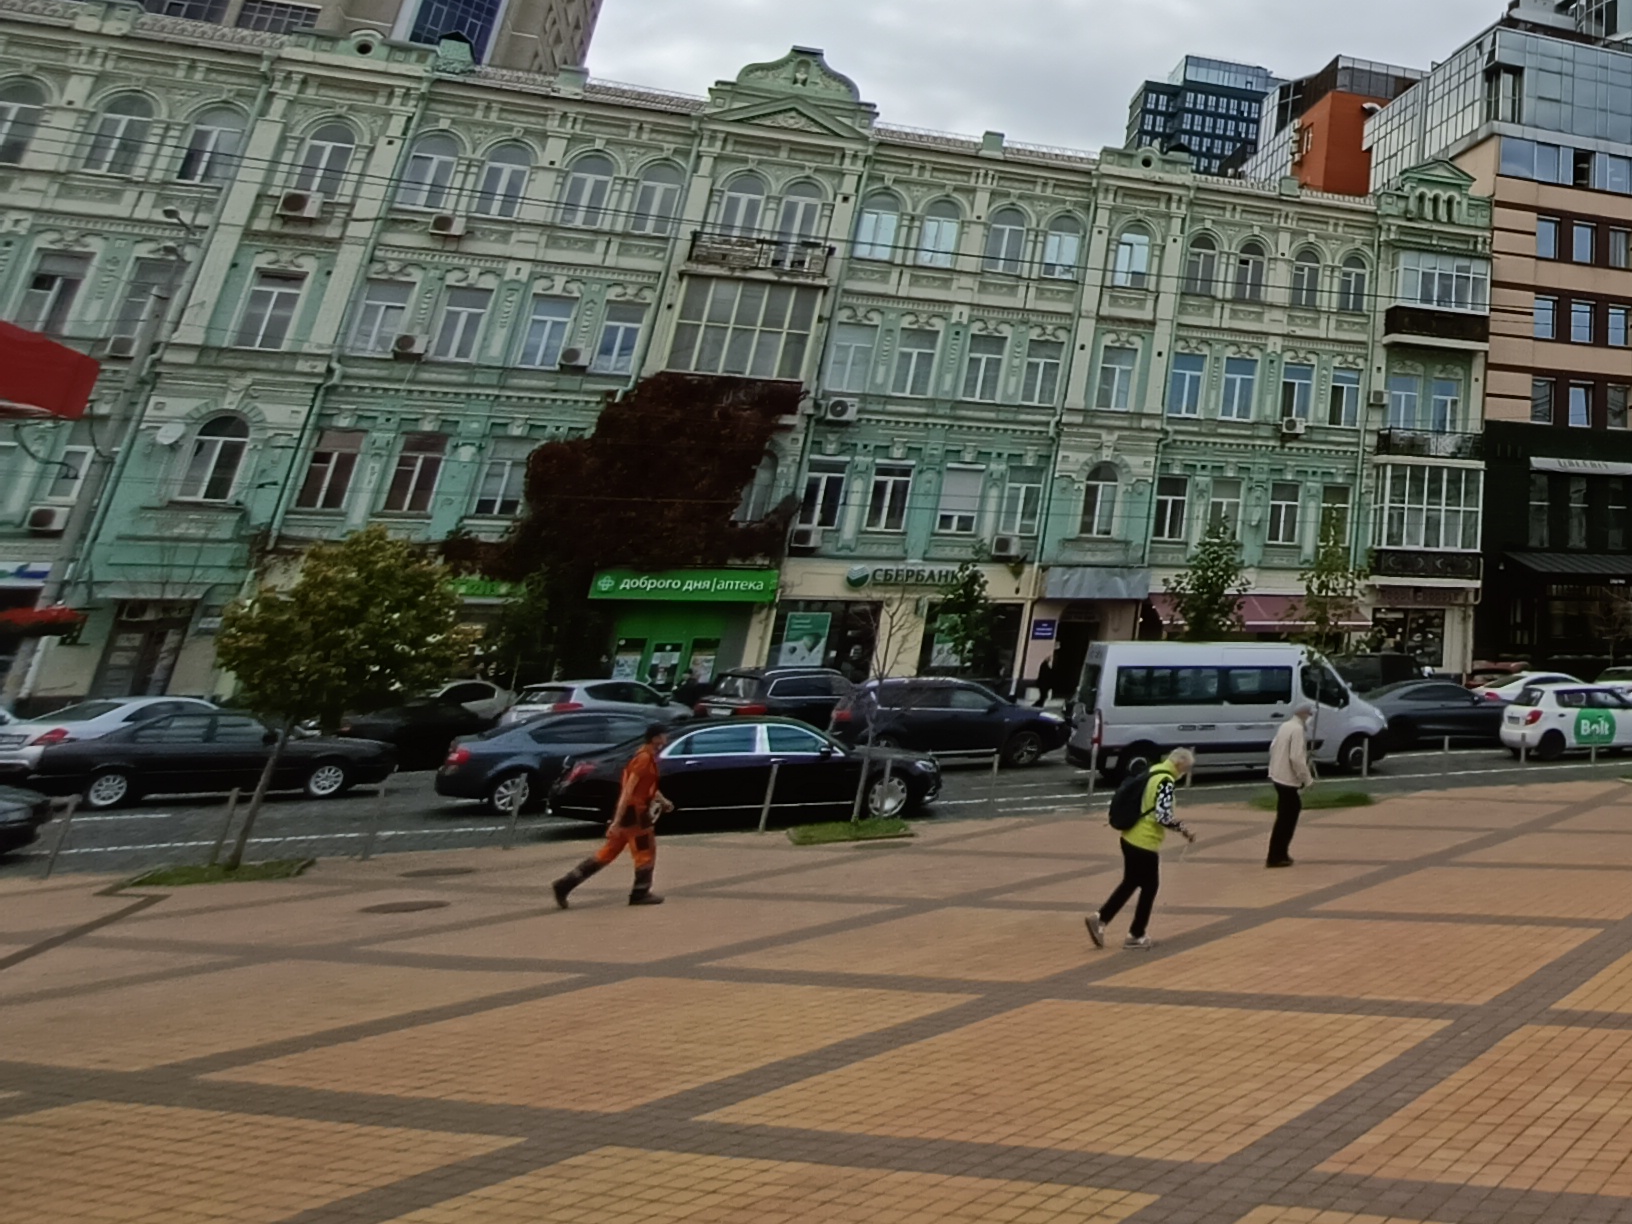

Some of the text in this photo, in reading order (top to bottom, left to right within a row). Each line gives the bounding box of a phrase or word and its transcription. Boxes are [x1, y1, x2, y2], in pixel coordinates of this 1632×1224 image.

[619, 576, 681, 592] доброго
[716, 579, 764, 591] аптека
[872, 567, 960, 584] СБЕРБАНК
[1580, 717, 1610, 736] Bolt
